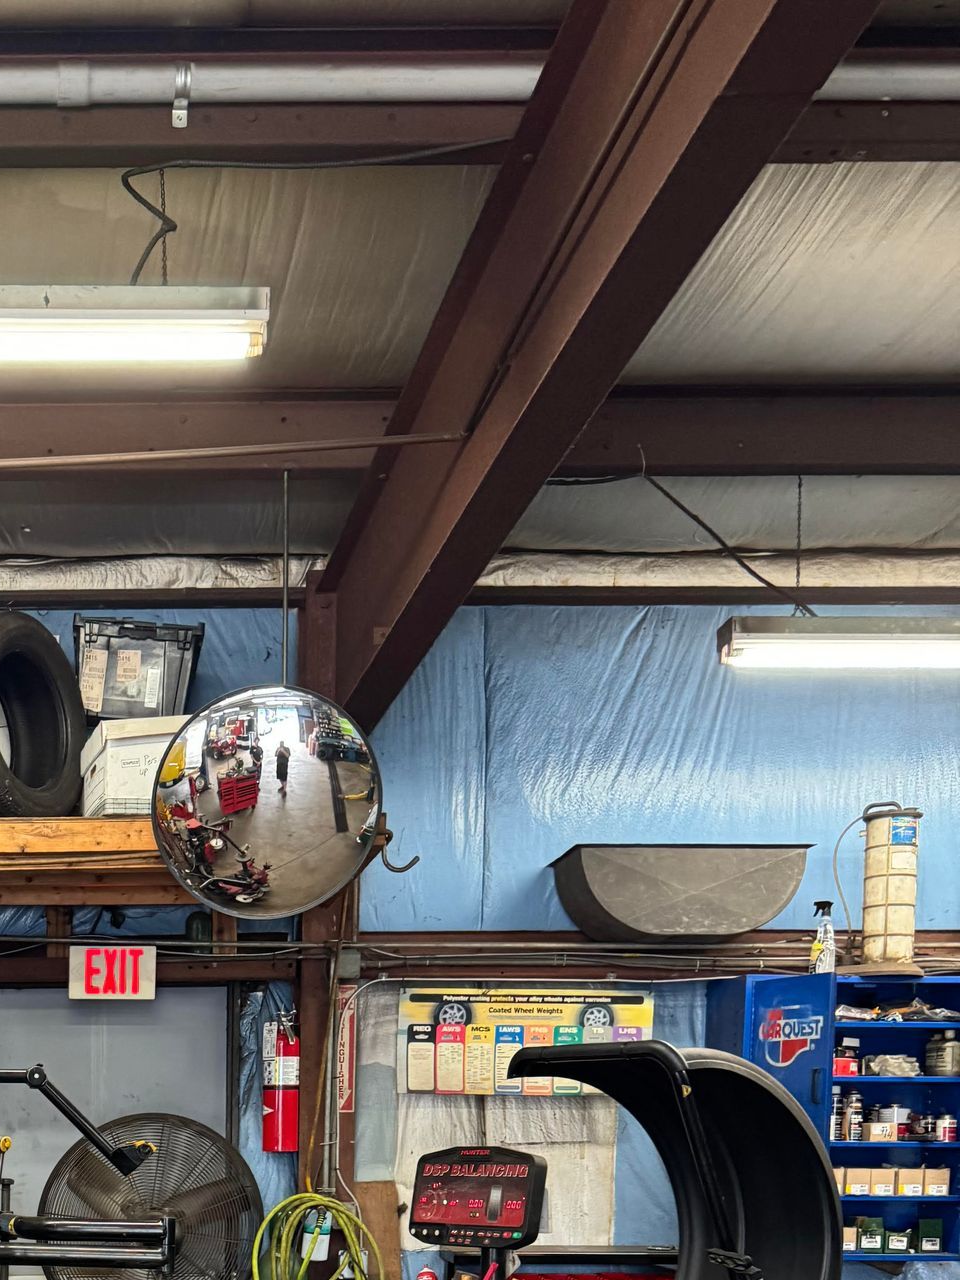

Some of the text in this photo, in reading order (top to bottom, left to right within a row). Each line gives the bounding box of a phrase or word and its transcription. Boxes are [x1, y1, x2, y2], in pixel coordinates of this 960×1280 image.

[84, 948, 144, 995] EXIT
[423, 1164, 529, 1178] DSP BALANCING
